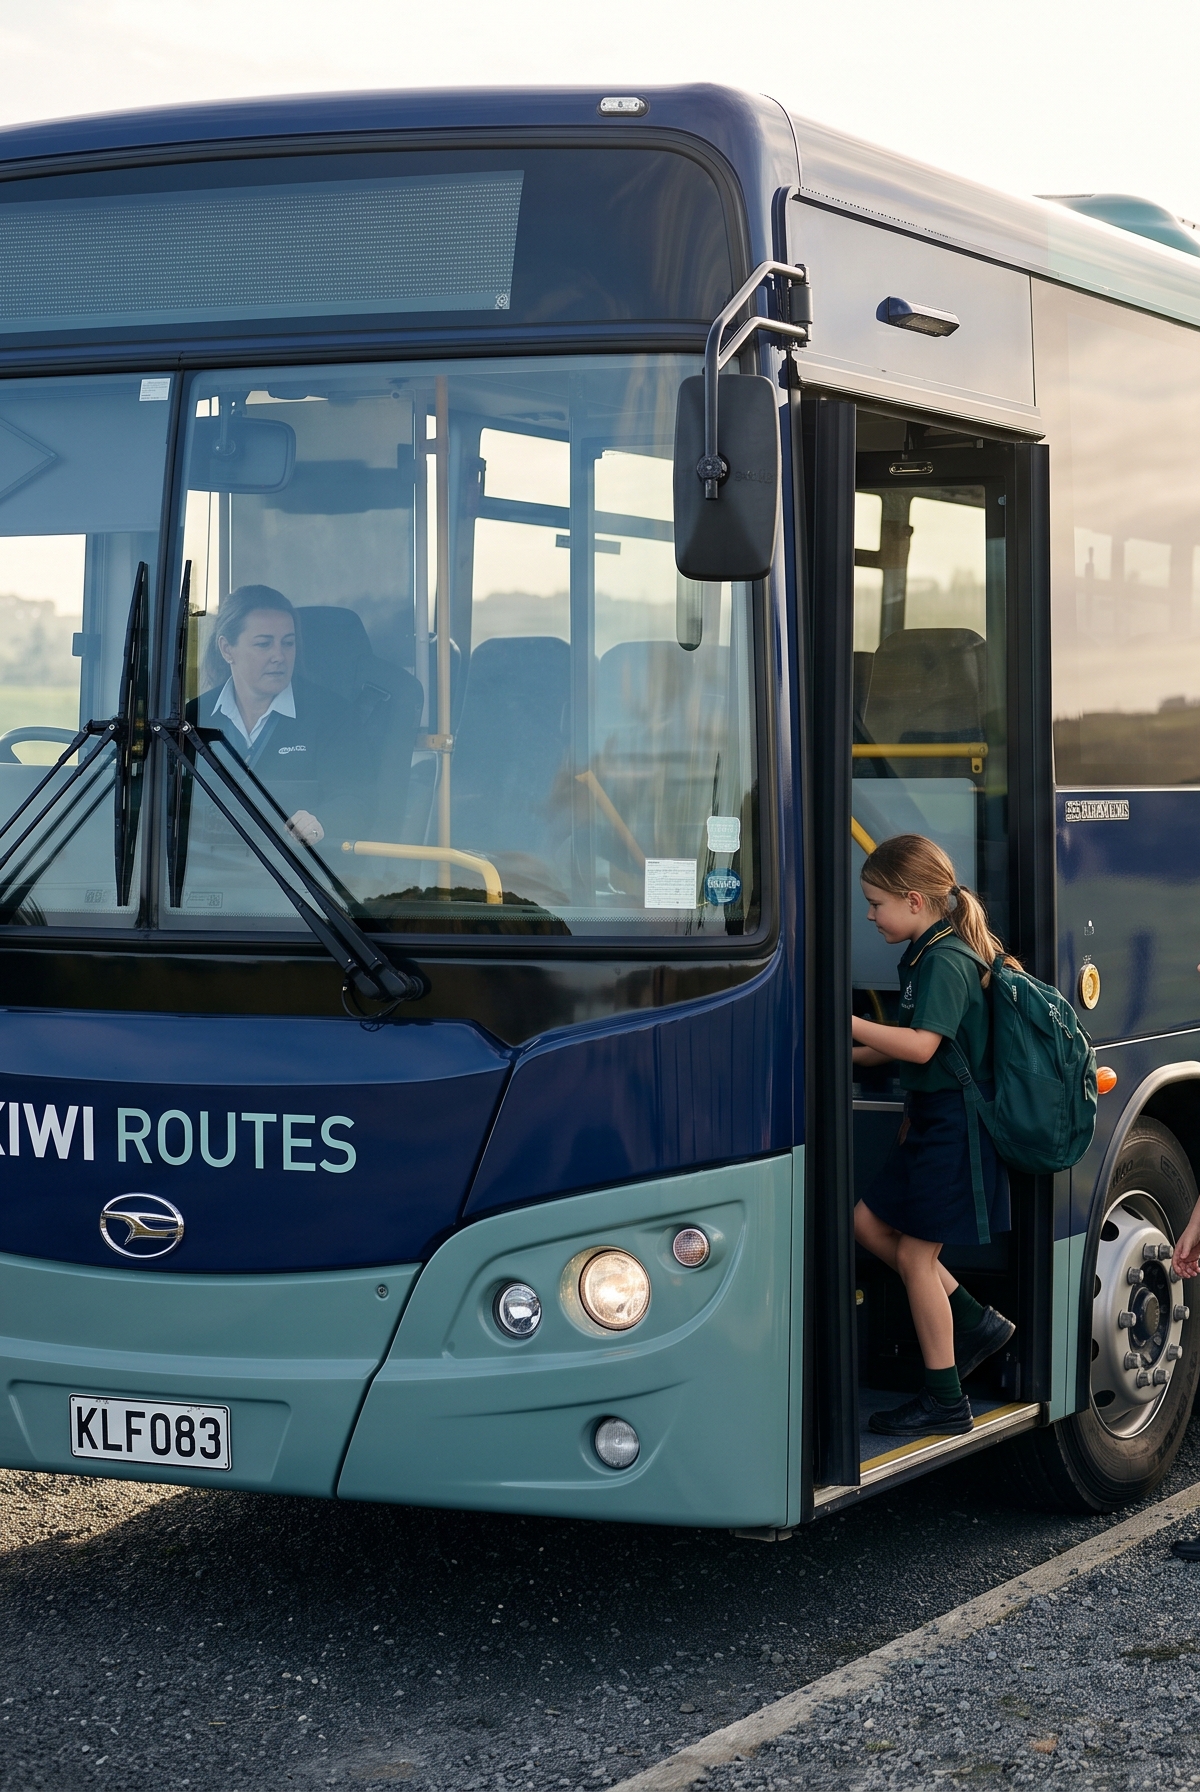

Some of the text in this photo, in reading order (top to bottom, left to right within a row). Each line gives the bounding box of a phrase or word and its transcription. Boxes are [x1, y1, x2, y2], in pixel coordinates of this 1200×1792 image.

[0, 1101, 357, 1174] IWI ROUTES
[76, 1406, 221, 1459] KLF083
